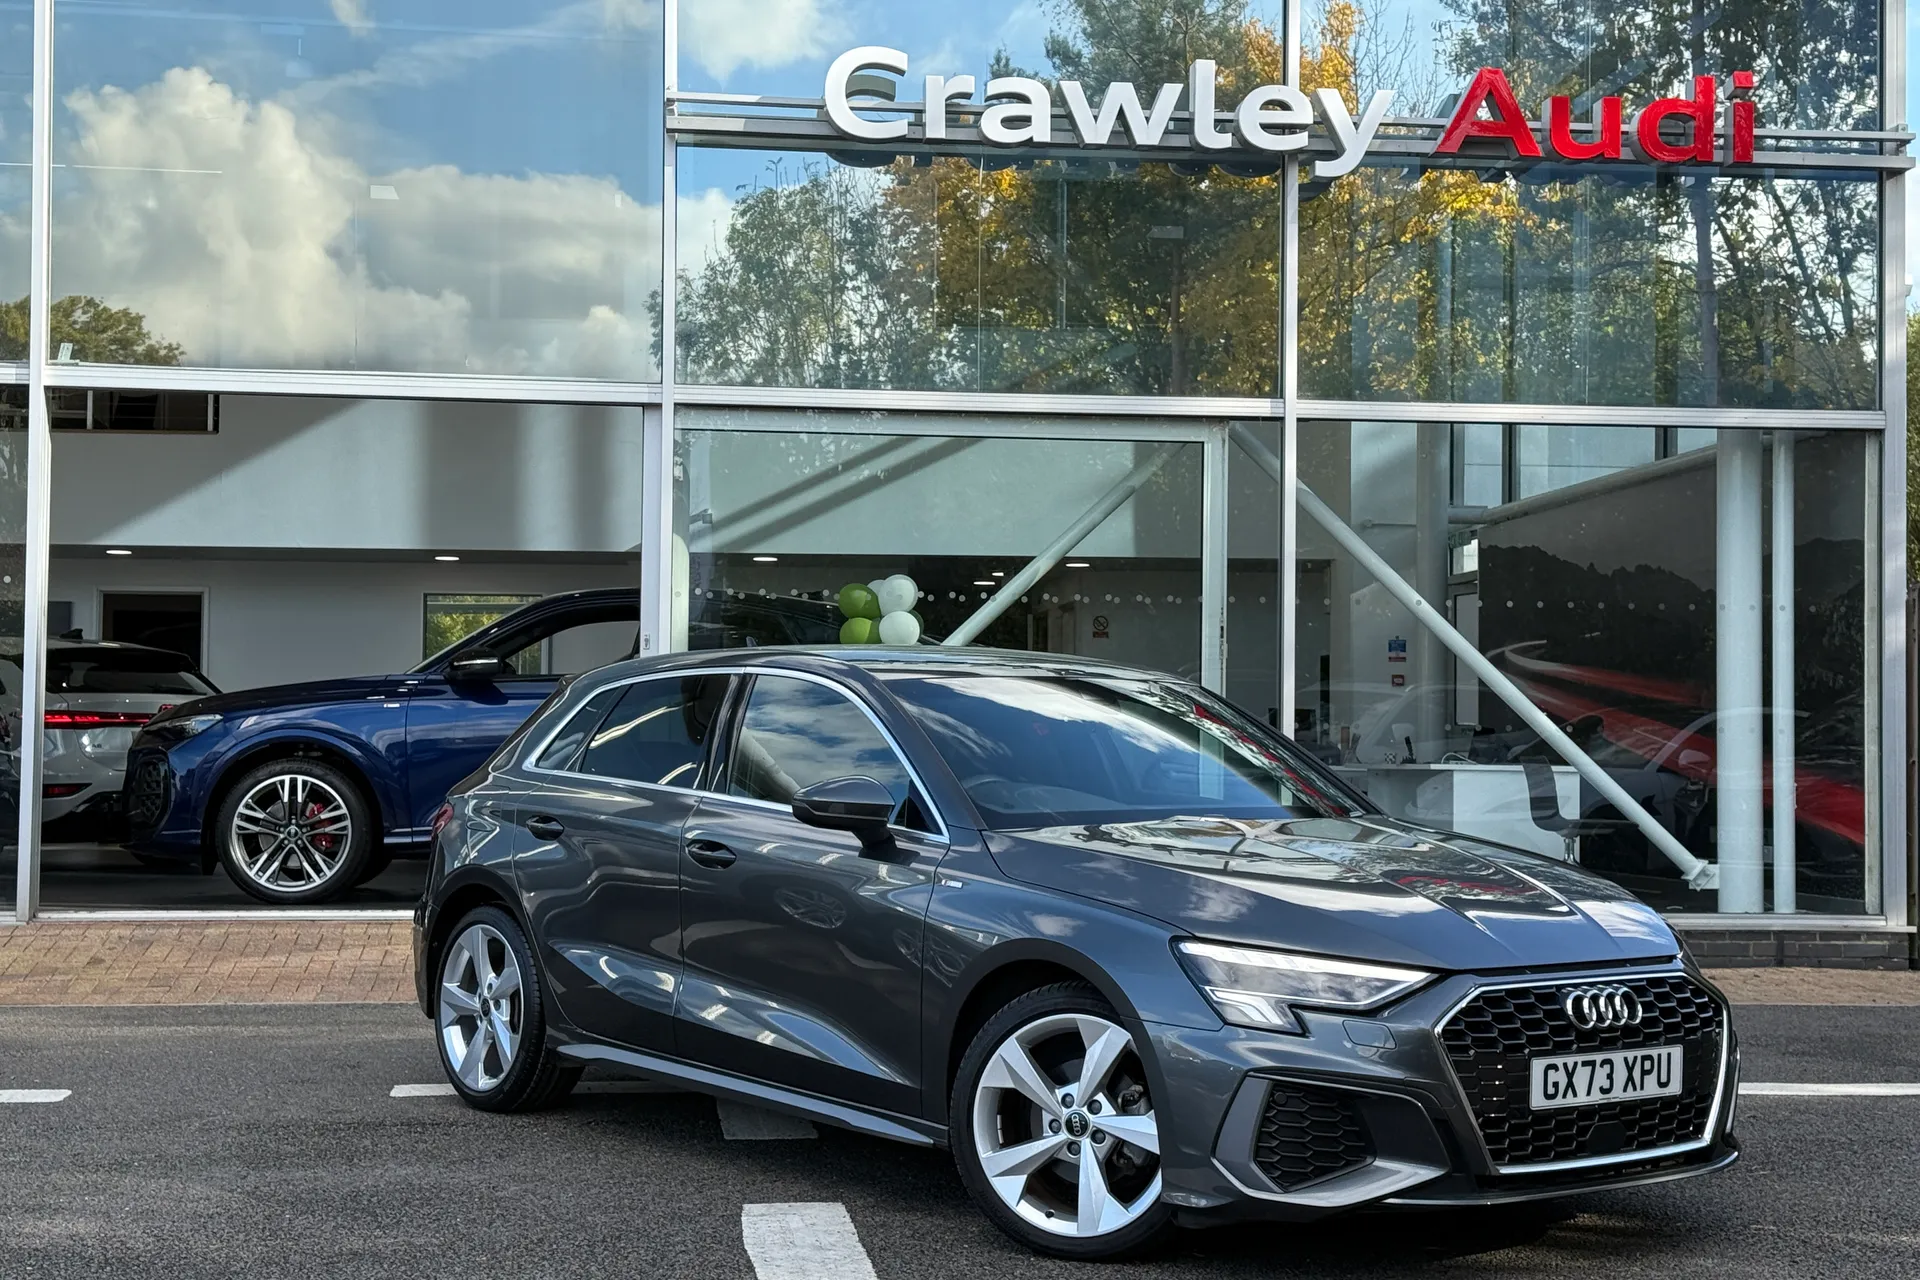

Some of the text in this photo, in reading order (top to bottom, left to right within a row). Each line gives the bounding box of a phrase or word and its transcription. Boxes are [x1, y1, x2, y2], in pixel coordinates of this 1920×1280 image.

[824, 46, 1755, 178] Crawley Audi
[1543, 1052, 1672, 1101] GX73 XPU
